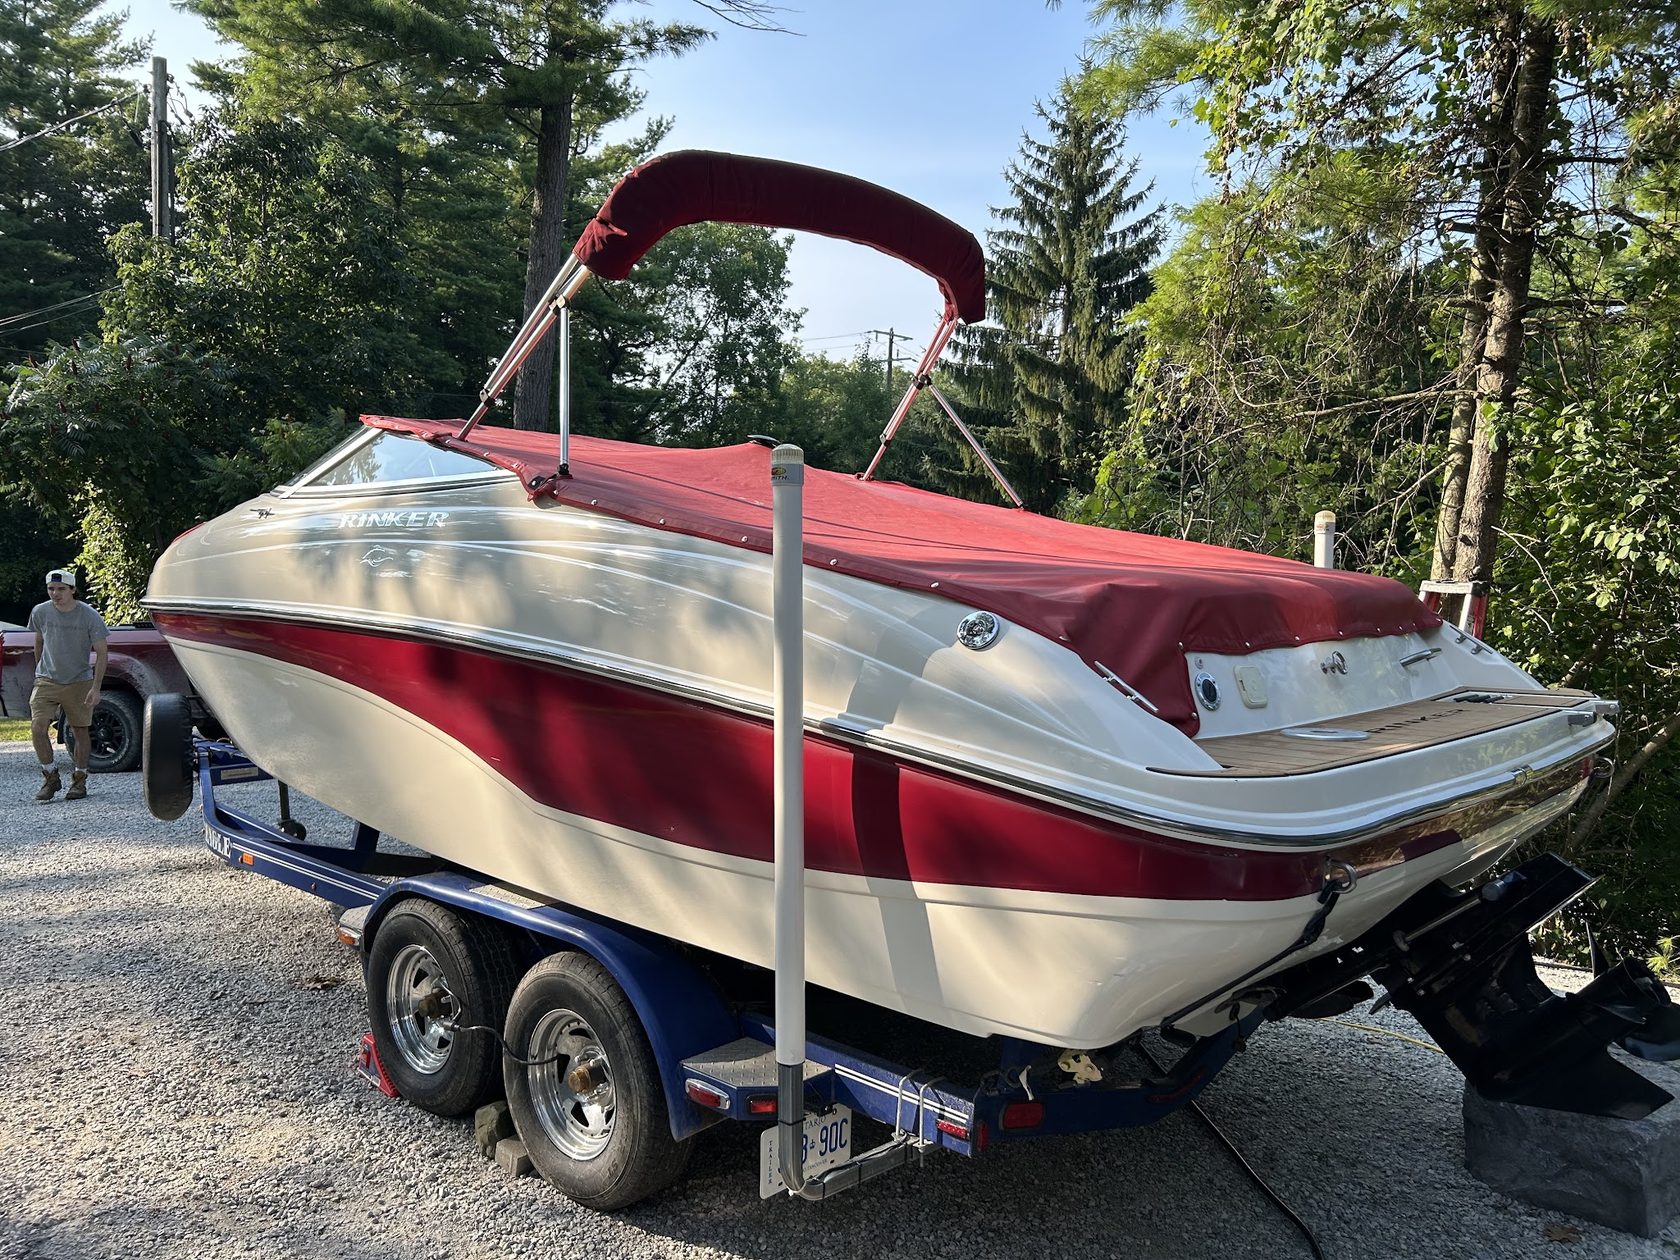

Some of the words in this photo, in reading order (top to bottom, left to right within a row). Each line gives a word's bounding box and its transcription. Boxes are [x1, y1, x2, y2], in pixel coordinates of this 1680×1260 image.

[338, 511, 450, 528] RINKER
[803, 1116, 827, 1130] TARIO
[819, 1118, 848, 1156] 90C
